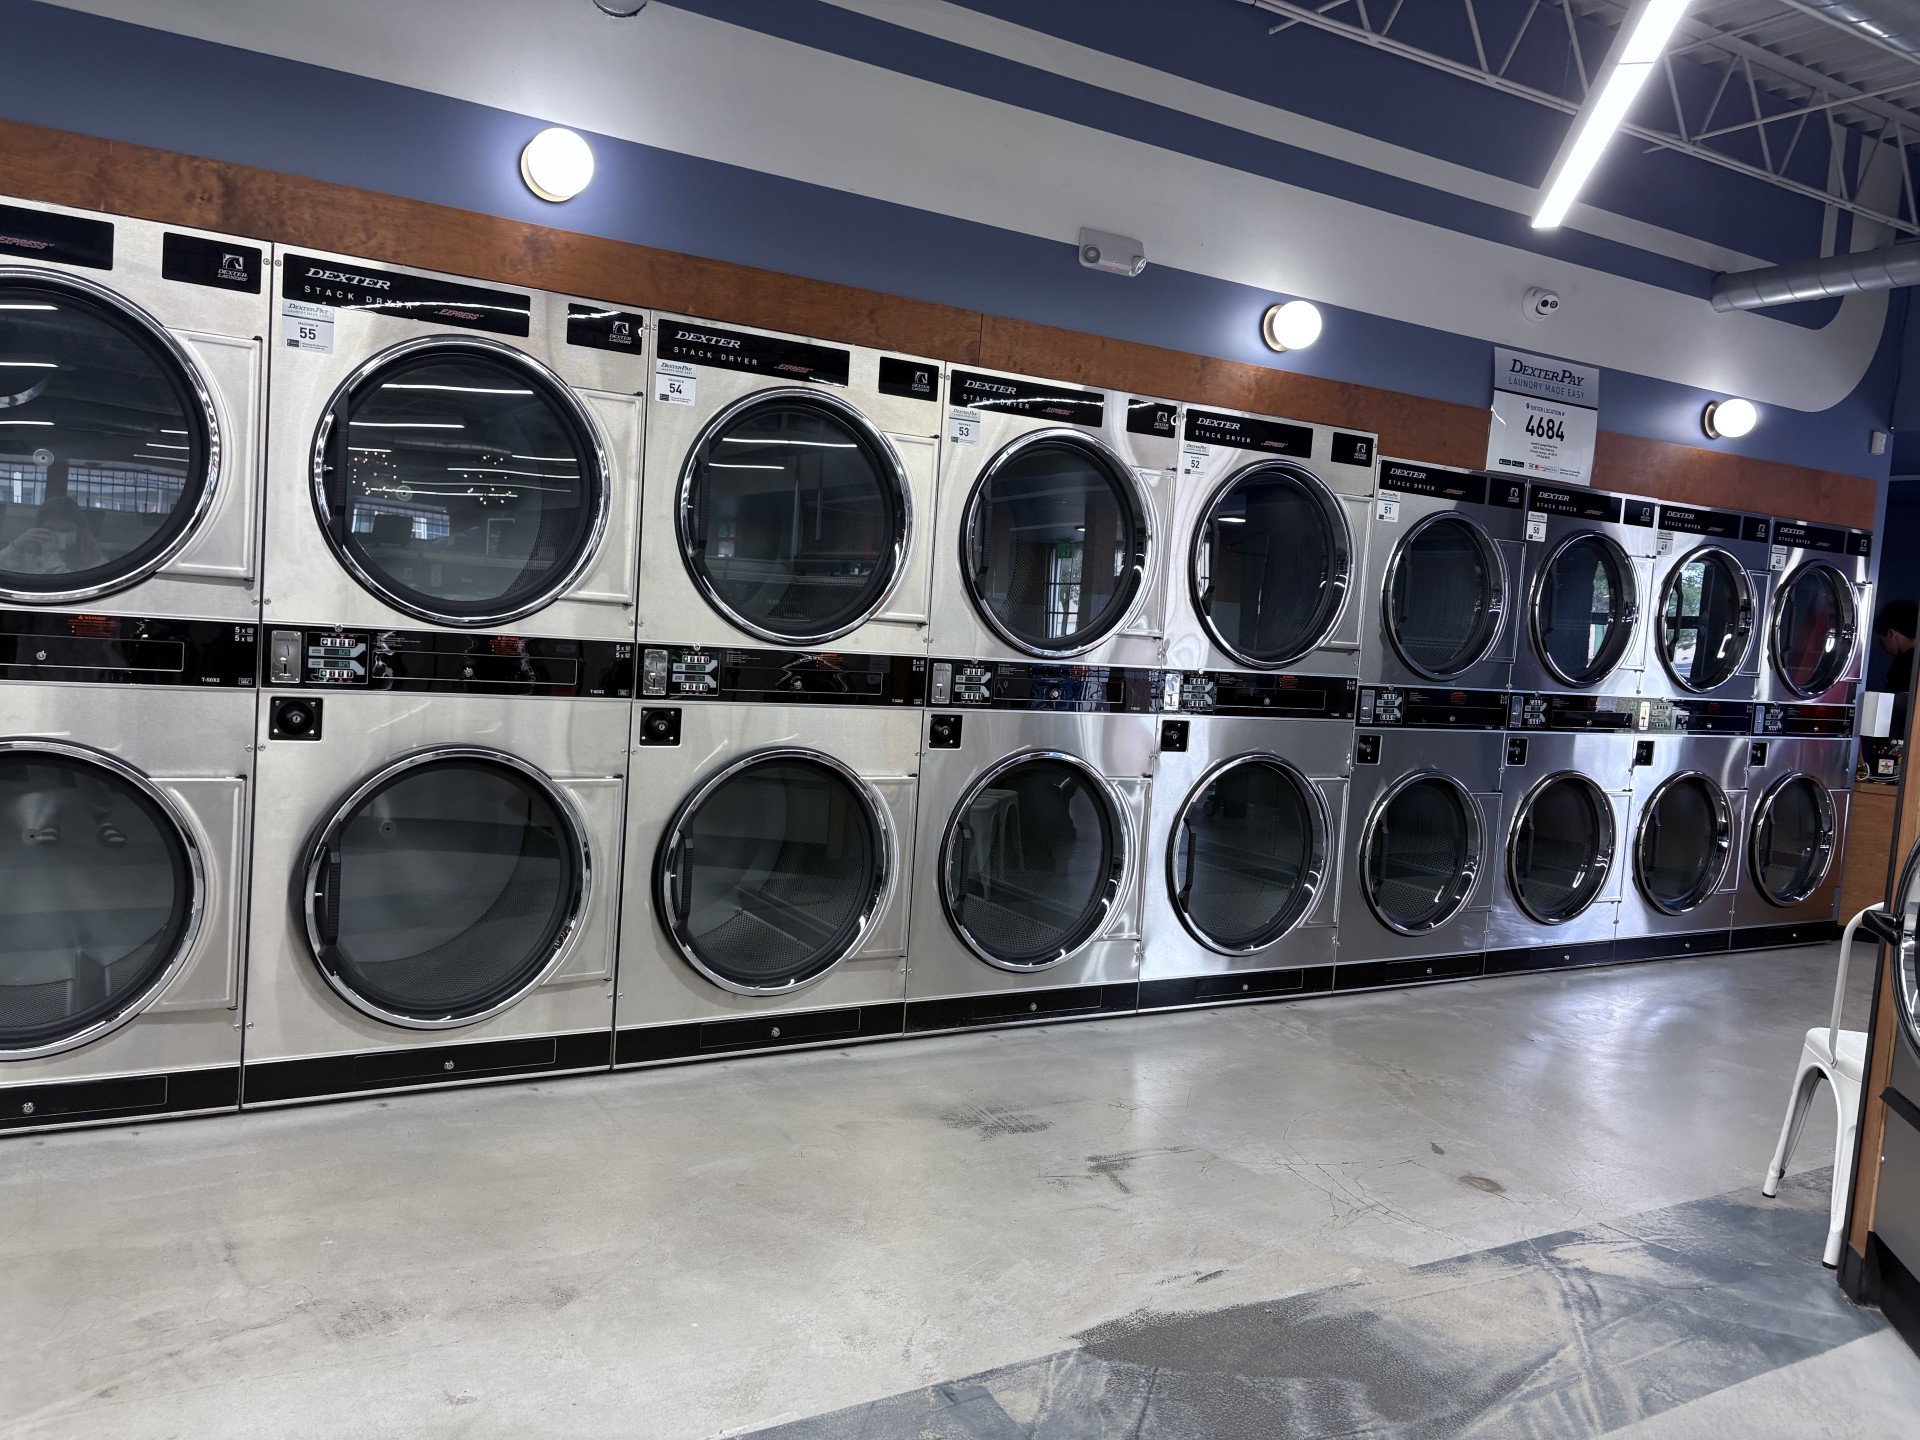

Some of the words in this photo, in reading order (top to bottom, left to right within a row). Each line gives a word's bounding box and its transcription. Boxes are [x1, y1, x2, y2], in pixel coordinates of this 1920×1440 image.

[304, 267, 391, 291] DEXTER
[304, 285, 355, 301] STACK
[438, 308, 480, 320] EXPRESS
[299, 326, 317, 341] 55
[674, 330, 741, 349] DEXTER
[673, 346, 713, 359] STACK
[720, 353, 758, 366] DRYER
[669, 382, 683, 395] 54
[963, 379, 1017, 395] DEXTER
[1508, 376, 1543, 391] LAUNDRY
[1544, 382, 1565, 396] MADE
[1567, 388, 1585, 400] EASY
[1530, 404, 1544, 413] ENTER
[1543, 407, 1562, 417] LOCATION
[1196, 417, 1241, 431] DEXTER
[1525, 414, 1565, 442] 4684
[958, 426, 970, 437] 53
[1195, 429, 1221, 439] STACK
[1226, 434, 1251, 443] DRYER
[1190, 459, 1200, 469] 52
[1389, 467, 1427, 480] DEXTER
[1388, 479, 1410, 488] STACK
[1413, 483, 1435, 491] DRYER
[1537, 491, 1570, 502] DEXTER
[1384, 506, 1392, 515] 51
[1666, 510, 1695, 520] DEXTER
[1779, 526, 1806, 536] DEXTER
[234, 634, 240, 642] 5
